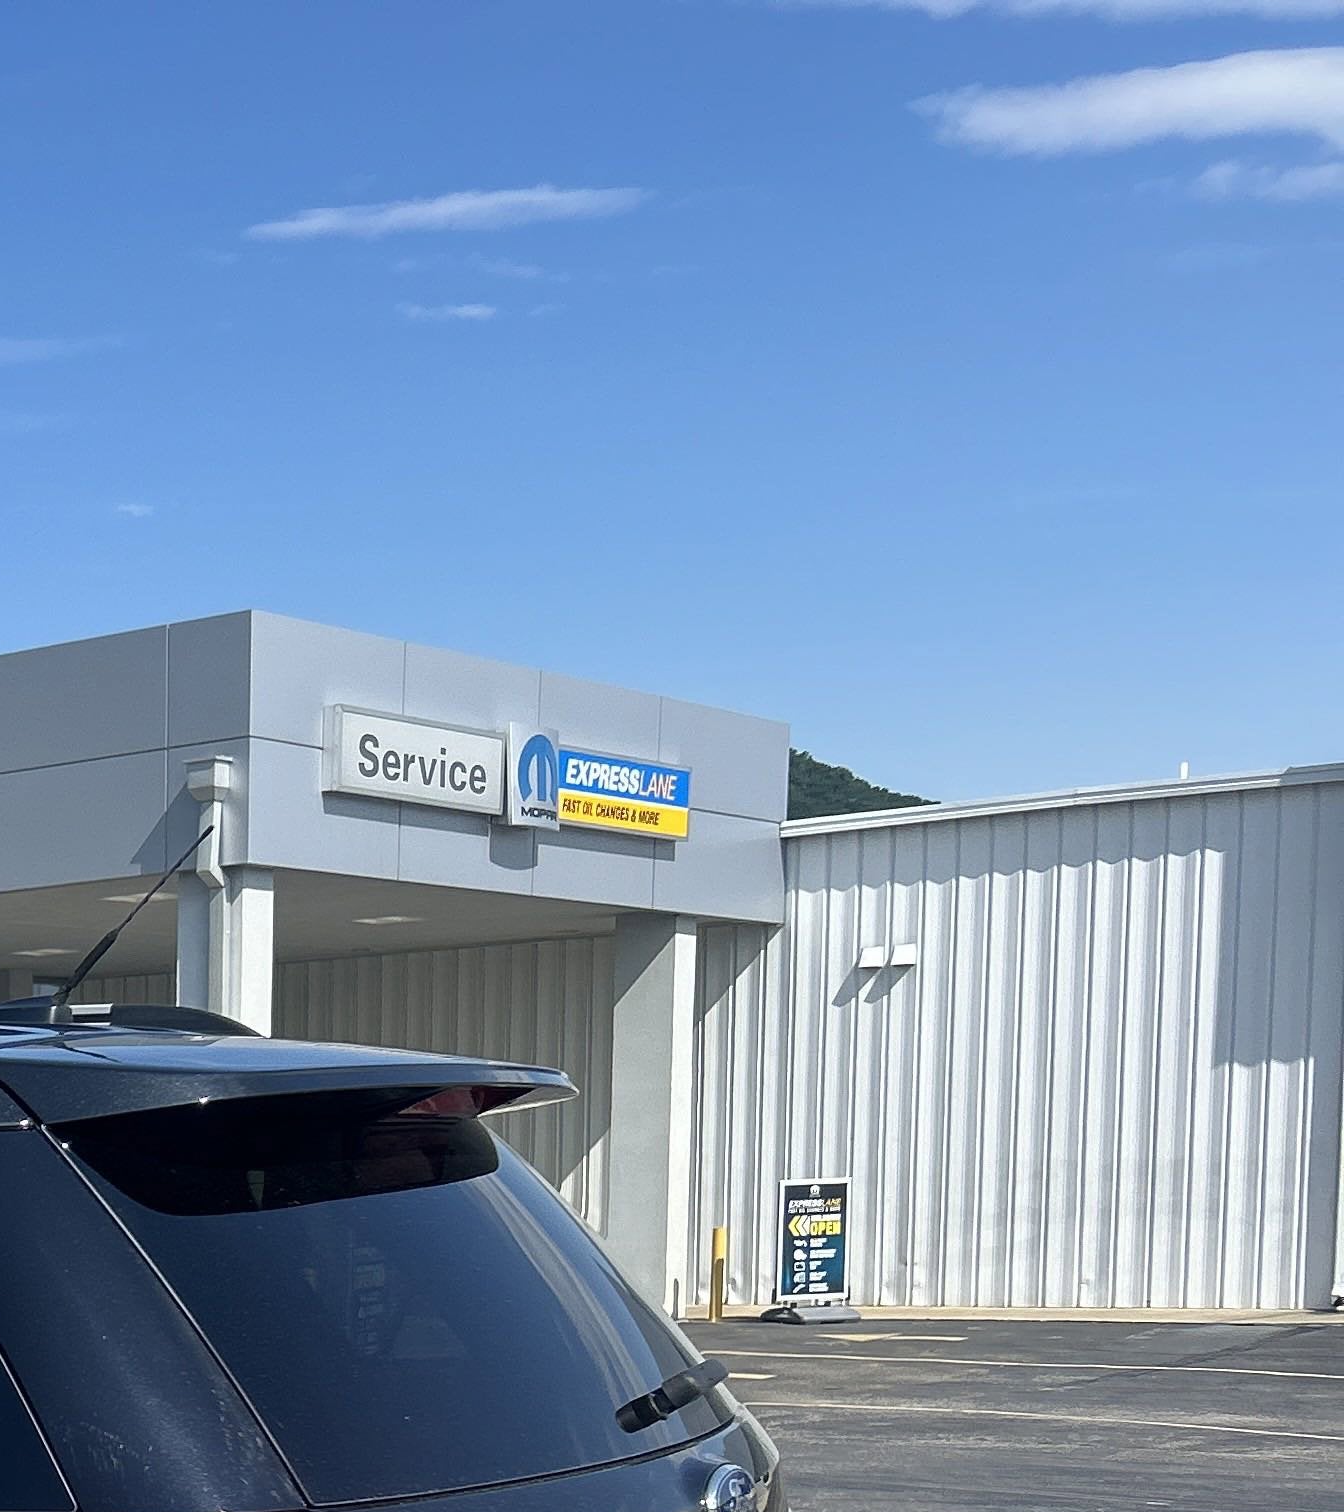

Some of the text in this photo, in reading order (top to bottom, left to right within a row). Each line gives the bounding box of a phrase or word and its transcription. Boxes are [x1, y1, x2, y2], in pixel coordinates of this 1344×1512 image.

[358, 733, 487, 795] Service
[562, 798, 660, 826] FAST OIL CHANGES & MORE
[810, 1220, 841, 1236] OPEN
